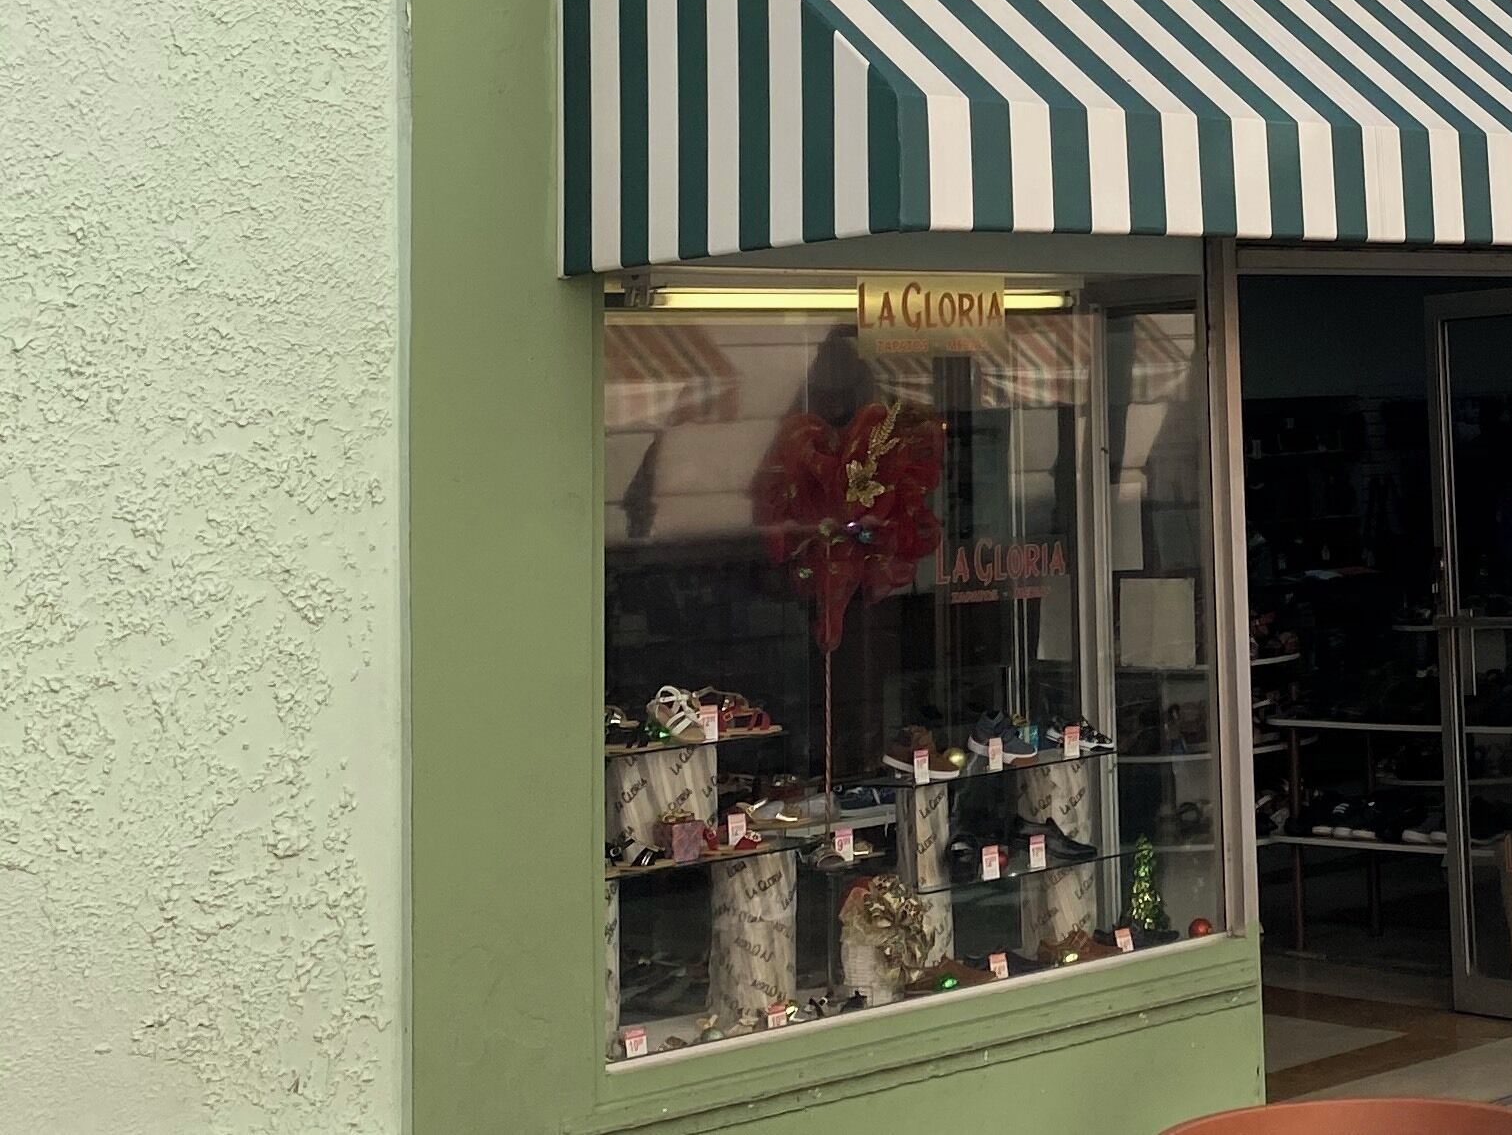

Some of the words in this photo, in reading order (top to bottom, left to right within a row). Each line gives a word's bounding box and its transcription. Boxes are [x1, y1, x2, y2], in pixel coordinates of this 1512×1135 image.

[858, 282, 895, 329] LA
[901, 281, 1004, 331] GLORIA
[935, 536, 970, 584] LA
[974, 537, 1066, 586] GLORIA
